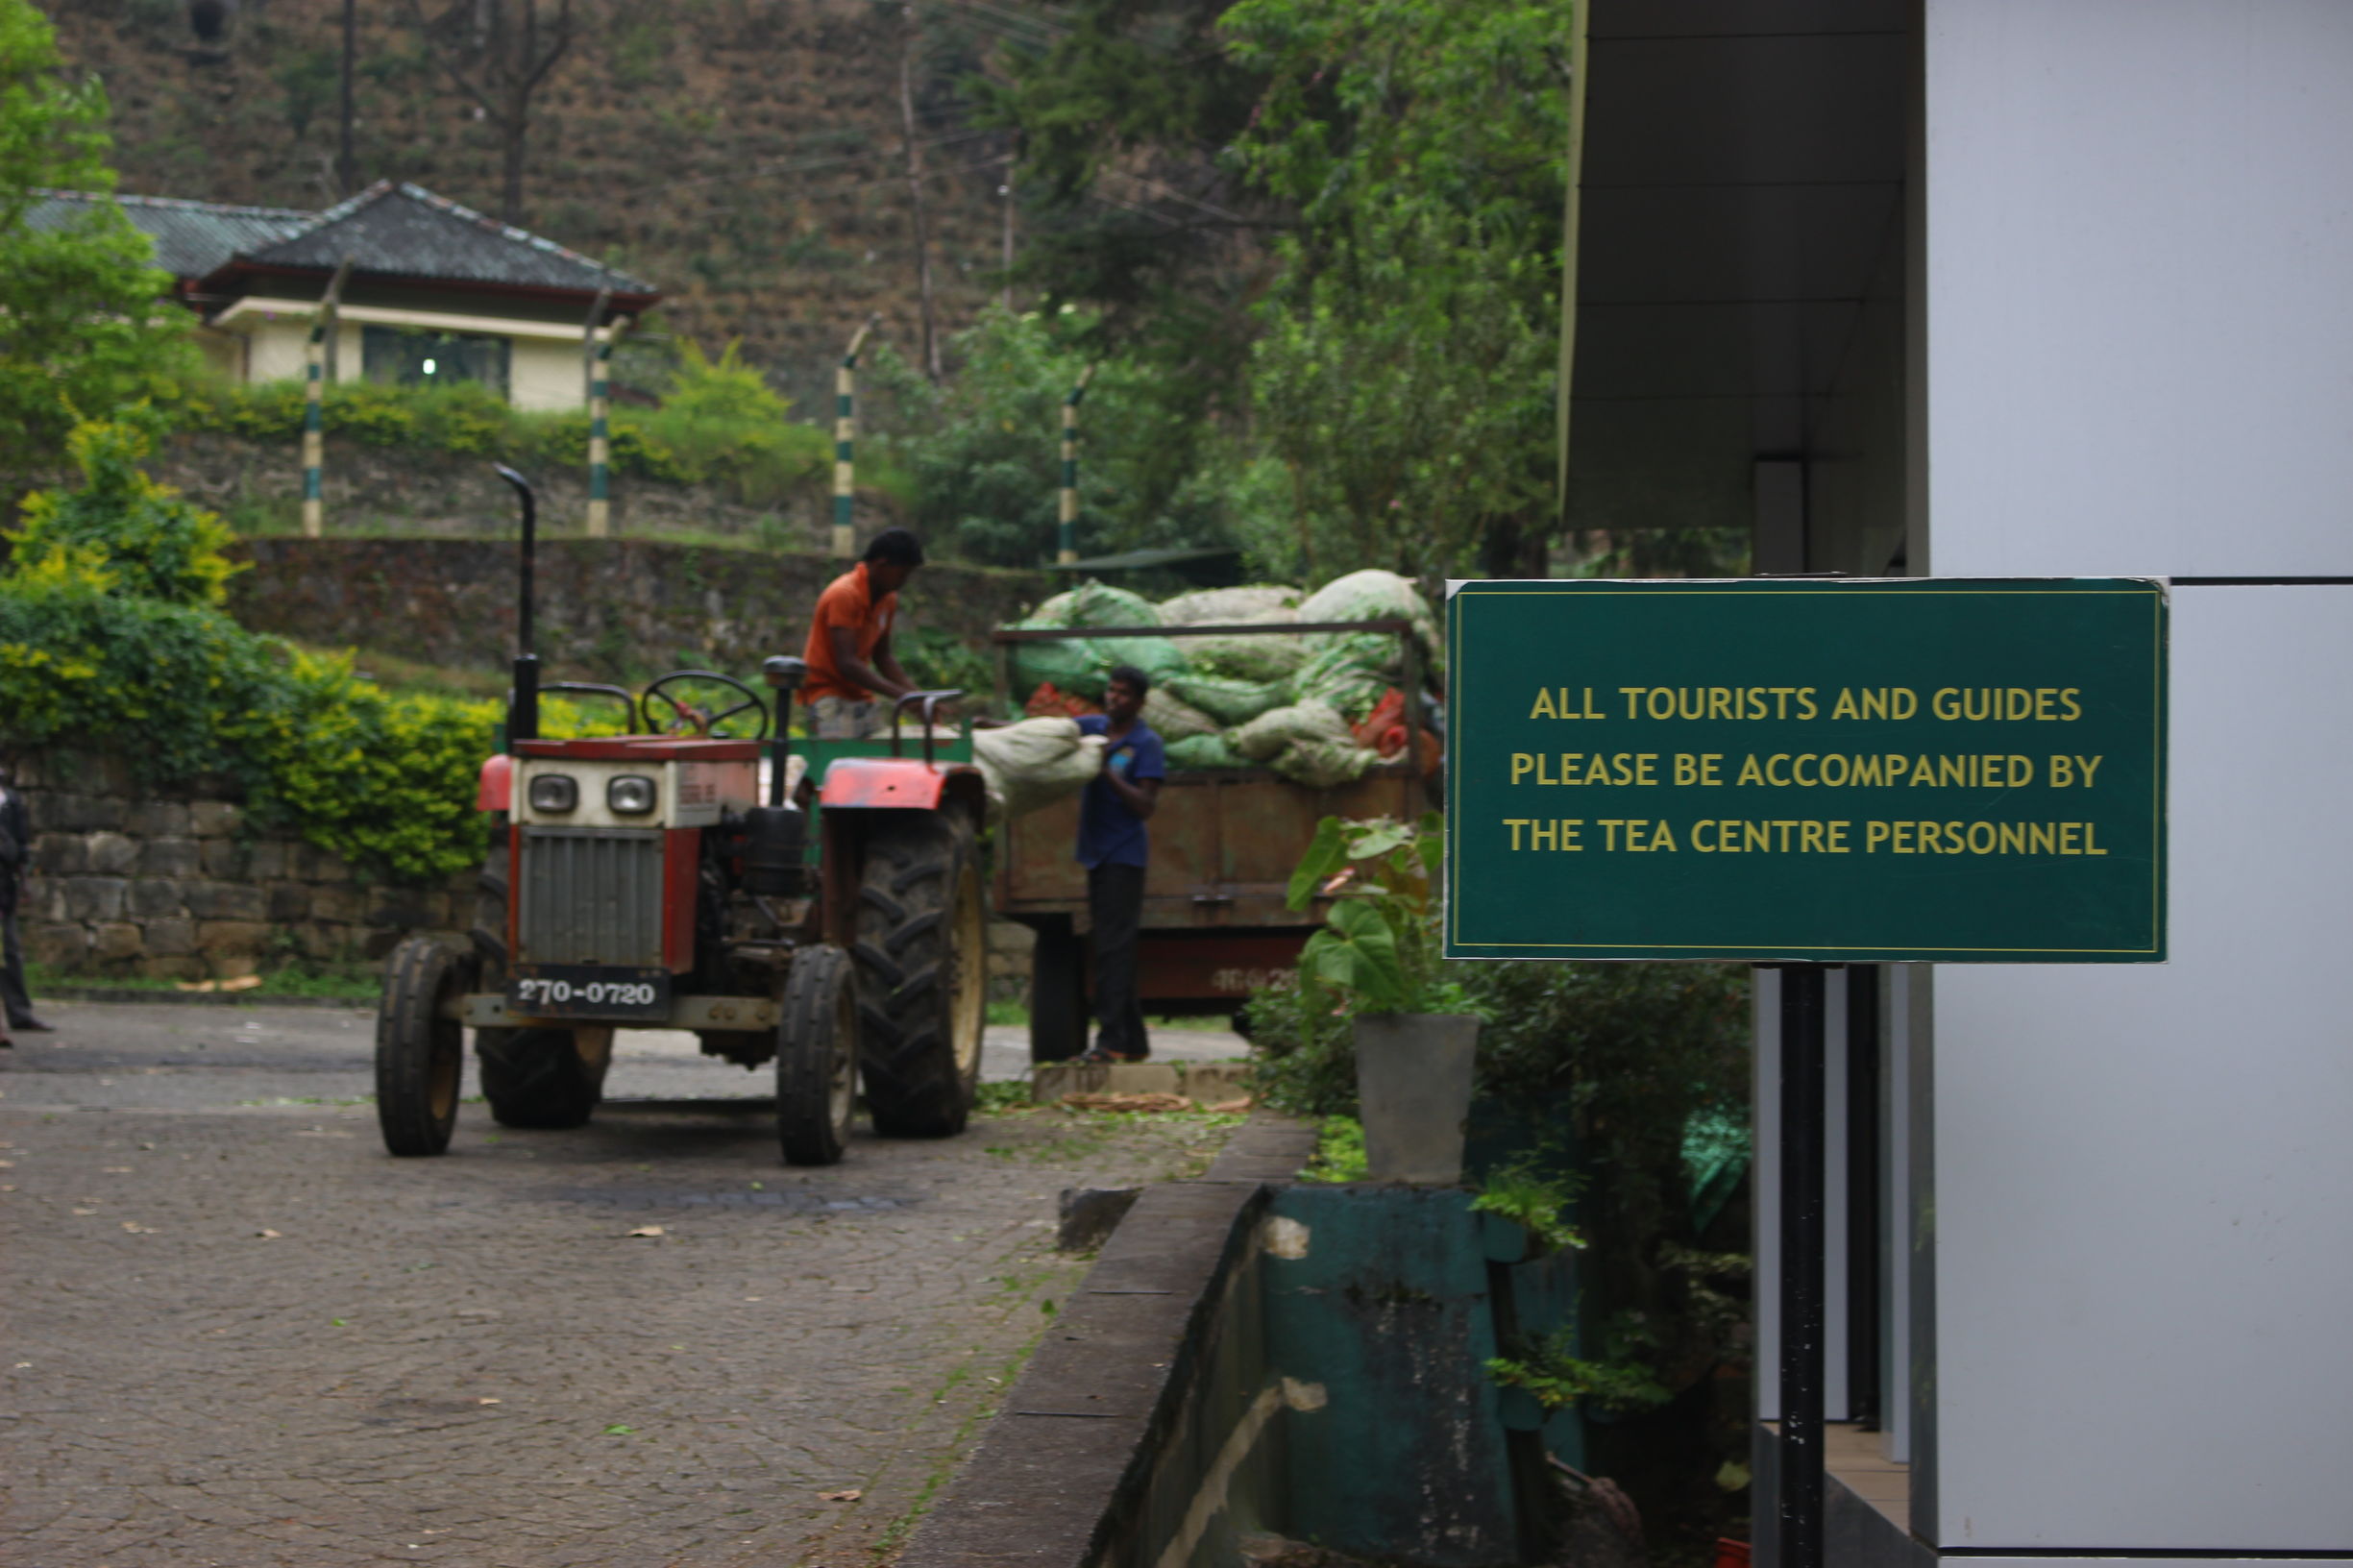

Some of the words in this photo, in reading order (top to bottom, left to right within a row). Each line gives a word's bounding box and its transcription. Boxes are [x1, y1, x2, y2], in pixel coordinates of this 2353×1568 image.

[1530, 687, 1605, 720] ALL
[1619, 687, 1818, 720] TOURISTS
[1831, 688, 1918, 721] AND
[1932, 688, 2082, 722] GUIDES
[1510, 753, 1658, 786] PLEASE
[1674, 753, 1724, 786] BE
[1736, 754, 2034, 788] ACCOMPANIED
[2049, 755, 2103, 788] BY
[1503, 819, 1583, 851] THE
[1597, 820, 1678, 852] TEA
[1690, 820, 1851, 853] CENTRE
[1866, 821, 2108, 855] PERSONNEL
[518, 978, 656, 1006] 270-0720
